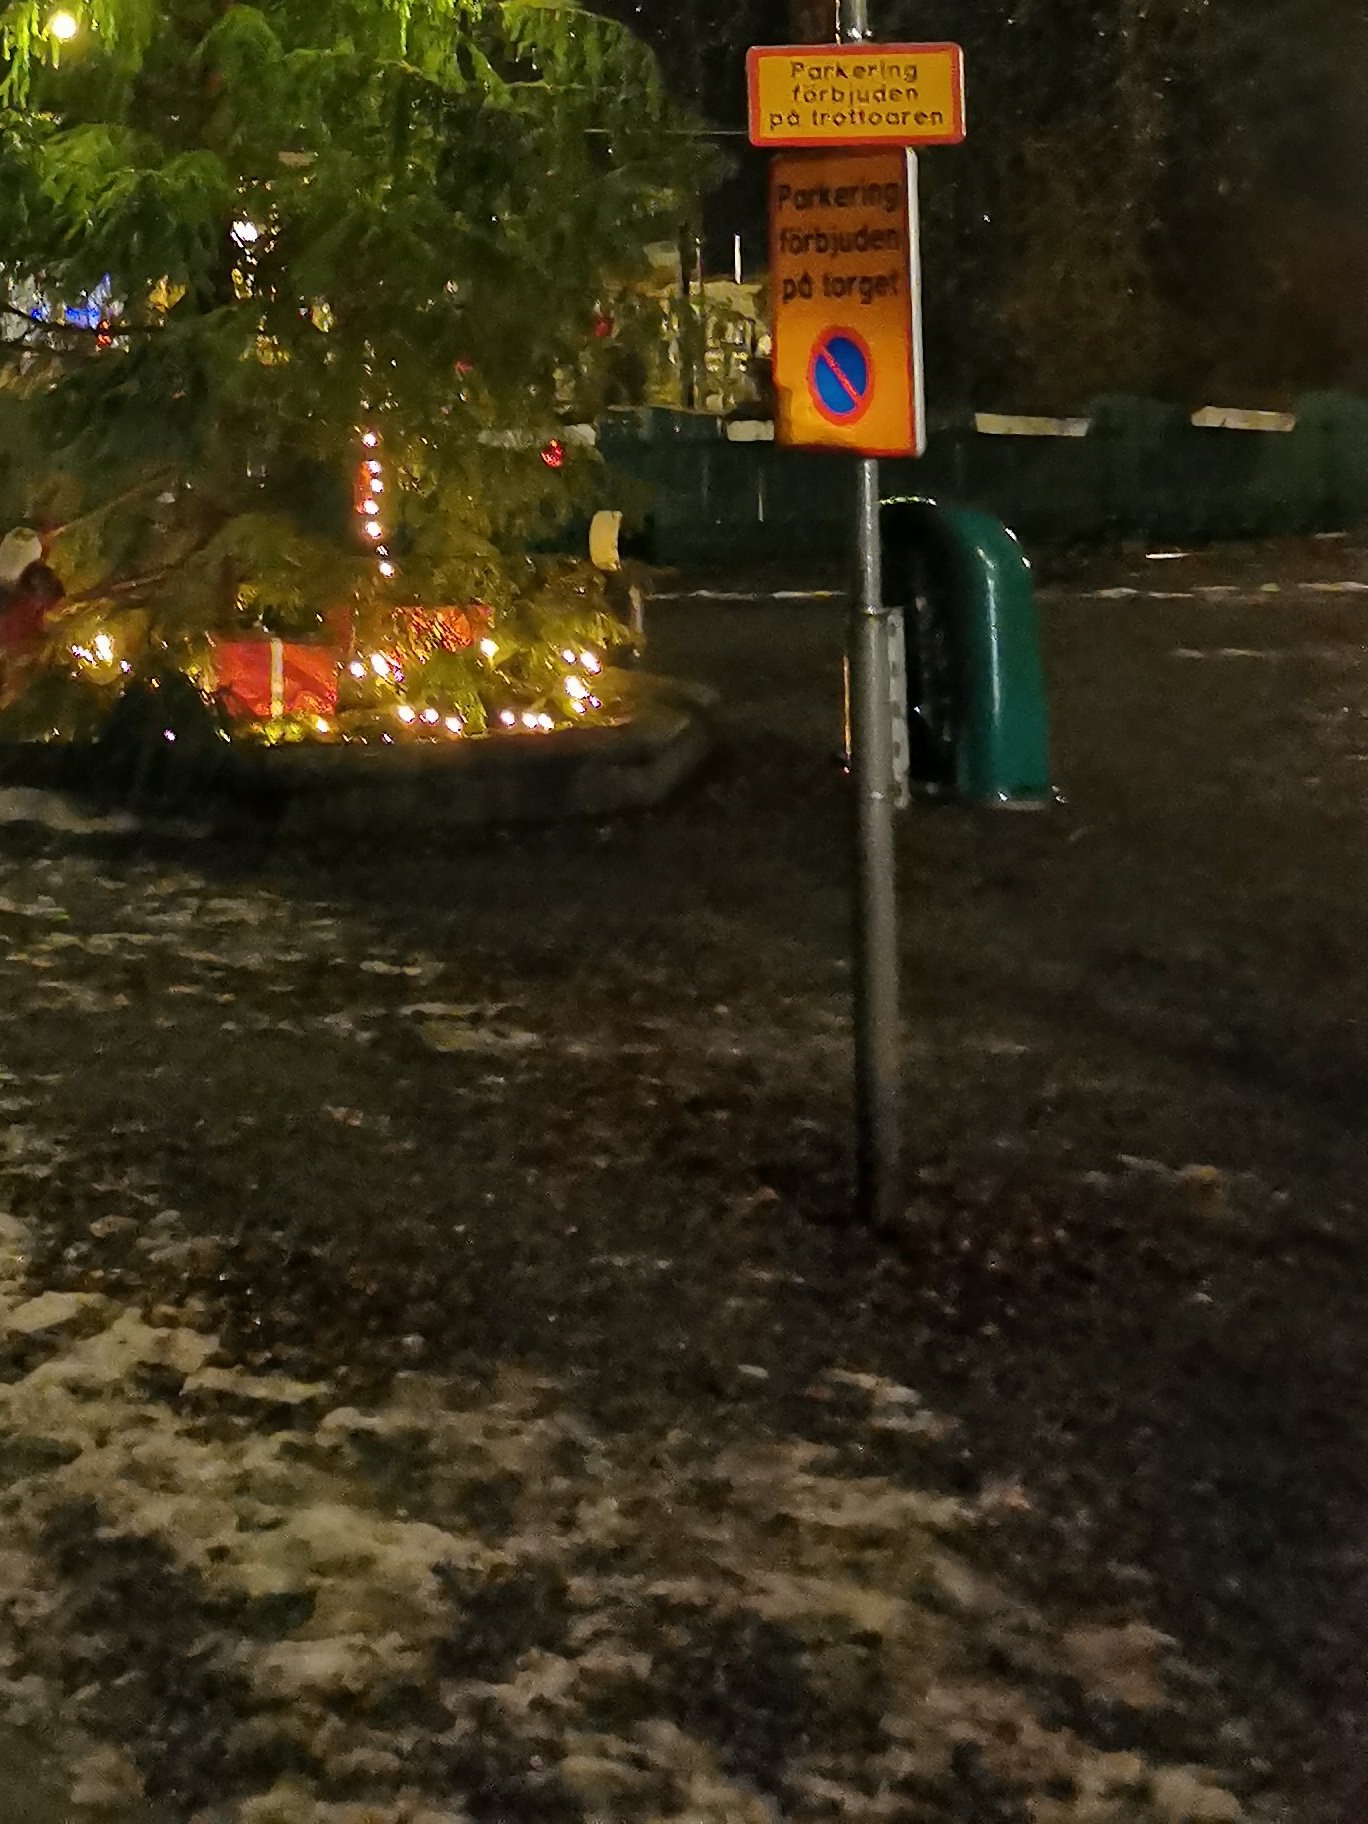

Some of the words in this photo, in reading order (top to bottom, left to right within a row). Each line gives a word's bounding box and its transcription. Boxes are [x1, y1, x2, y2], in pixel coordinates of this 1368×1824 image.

[790, 60, 918, 83] Parkering
[792, 84, 919, 105] förbjuden
[769, 111, 800, 131] på
[812, 108, 944, 127] trottoaren
[778, 182, 900, 213] Parkering
[779, 225, 900, 258] förbjuden
[782, 271, 812, 304] på
[822, 271, 899, 304] torget
